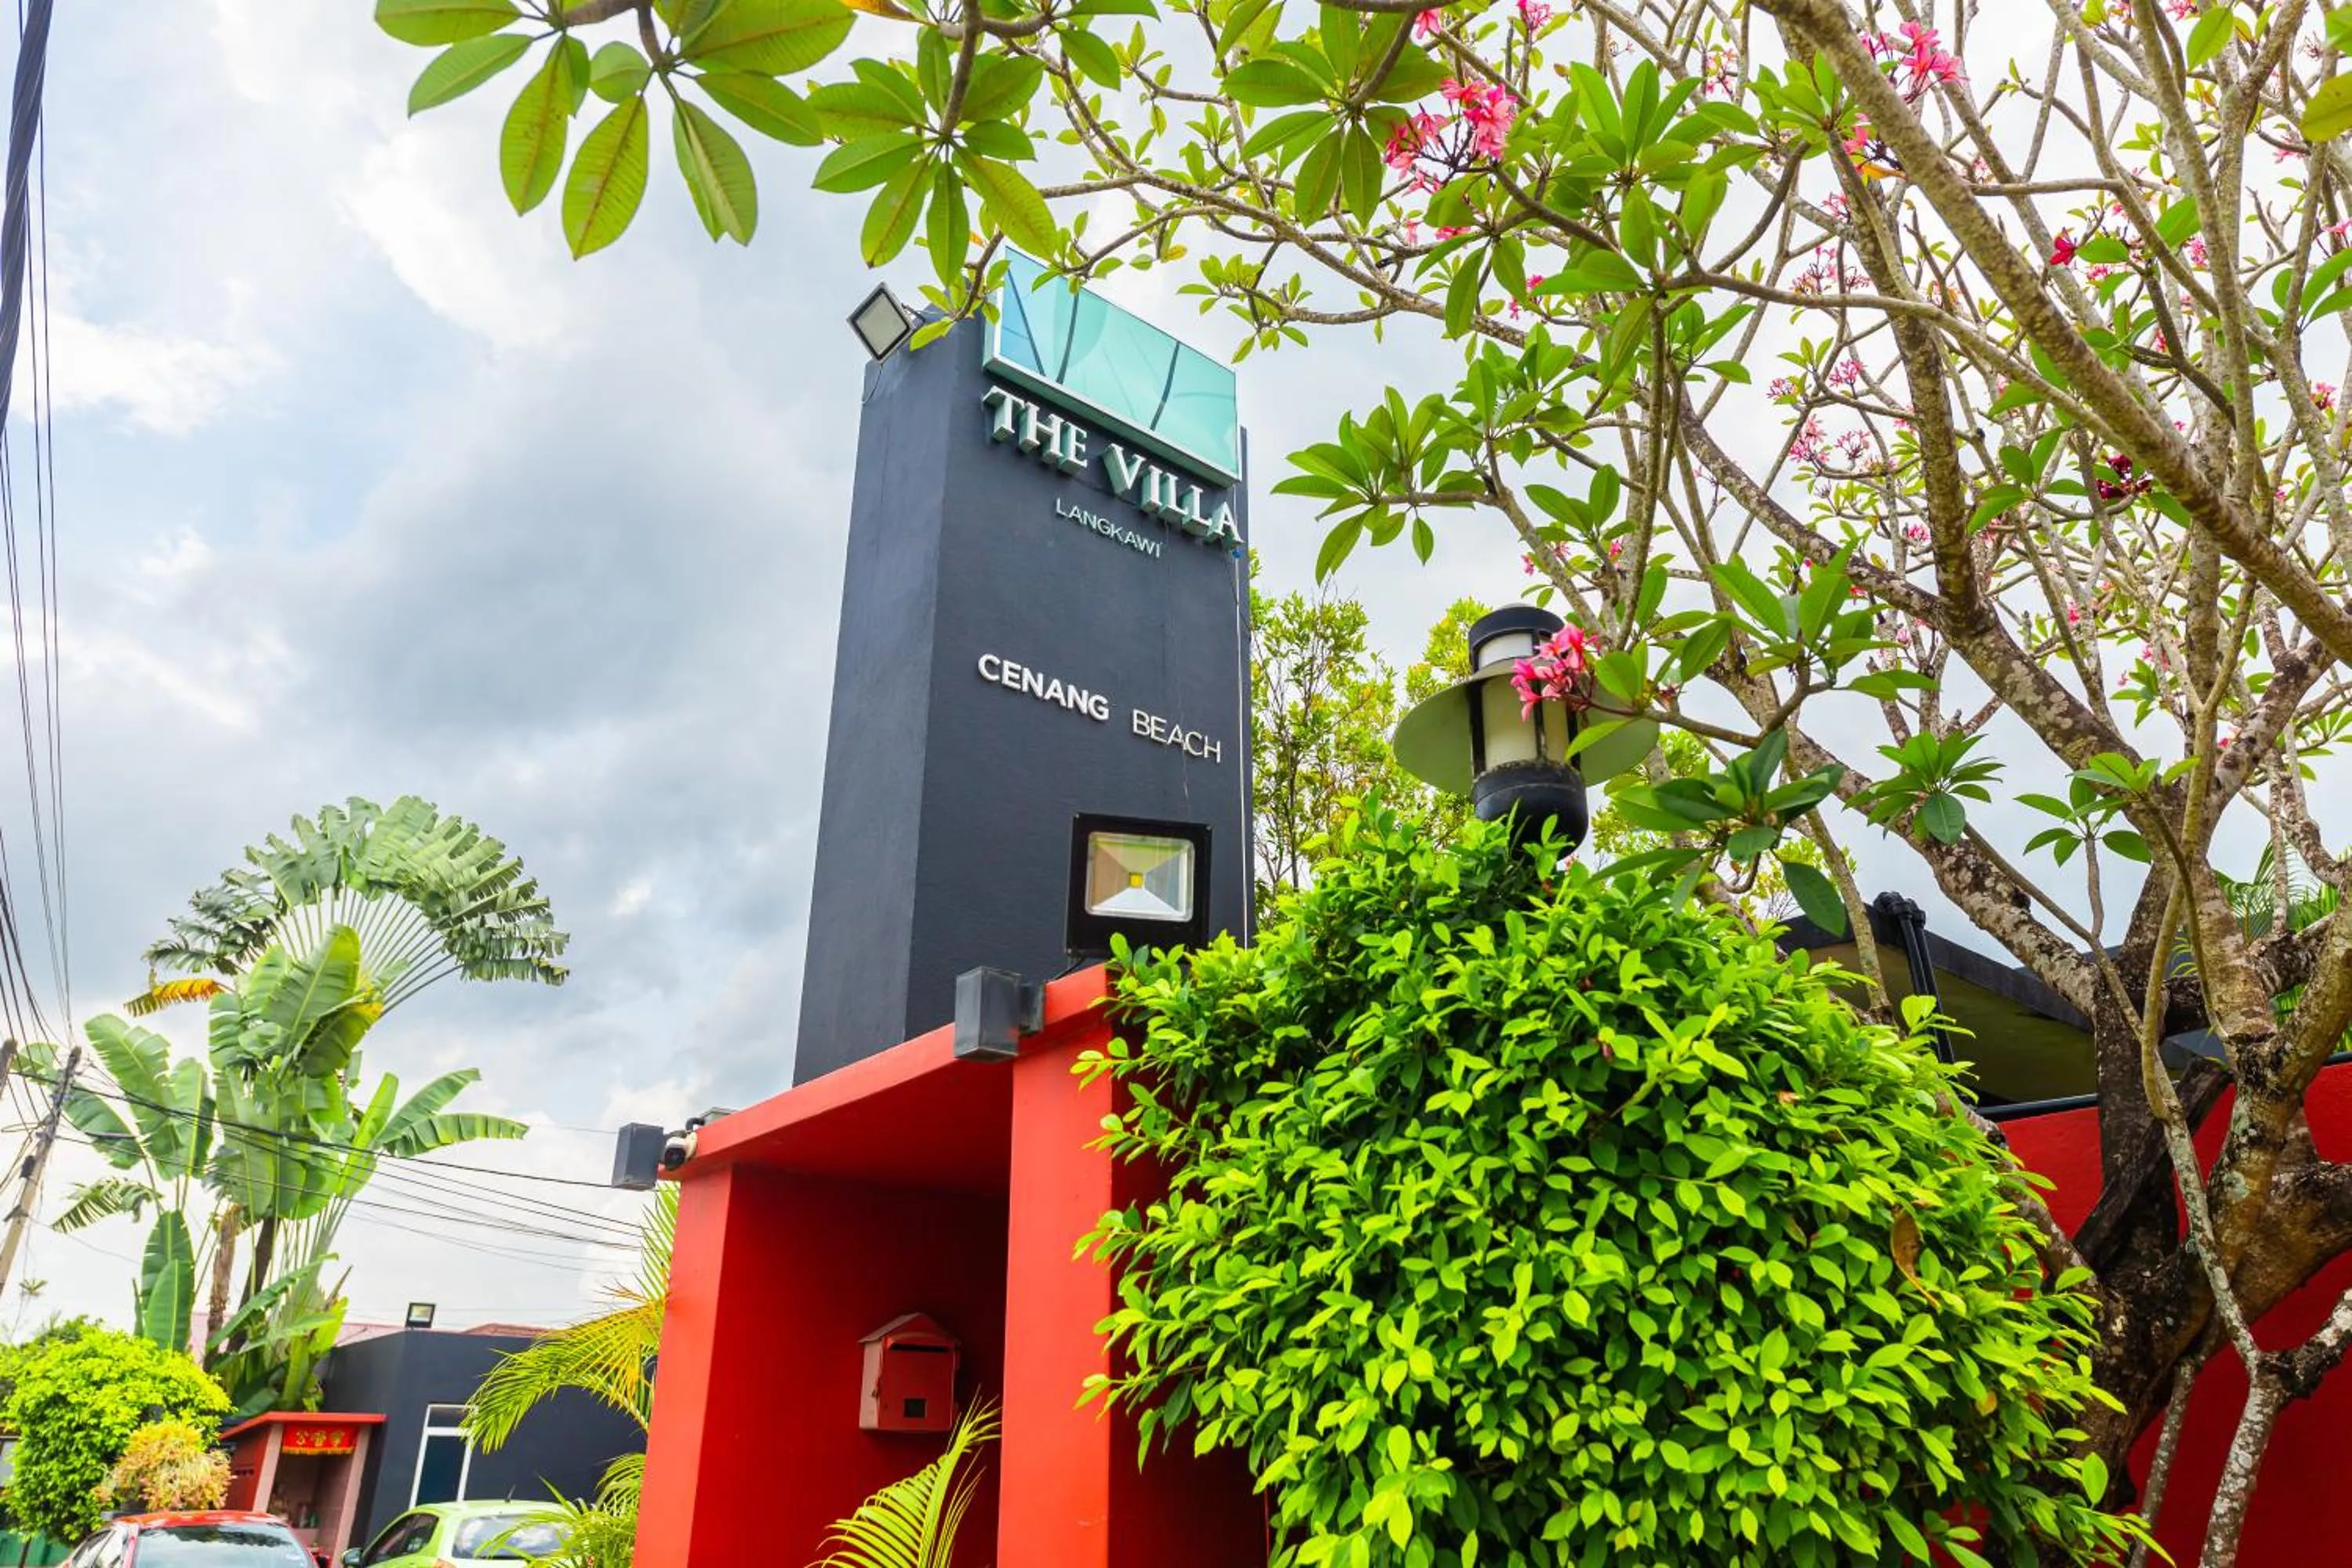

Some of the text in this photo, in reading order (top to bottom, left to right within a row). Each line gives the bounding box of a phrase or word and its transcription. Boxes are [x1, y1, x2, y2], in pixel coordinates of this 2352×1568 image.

[982, 385, 1244, 547] THE VILLA
[1055, 497, 1161, 558] LANGKAWI
[978, 653, 1221, 763] CENANG BEACH
